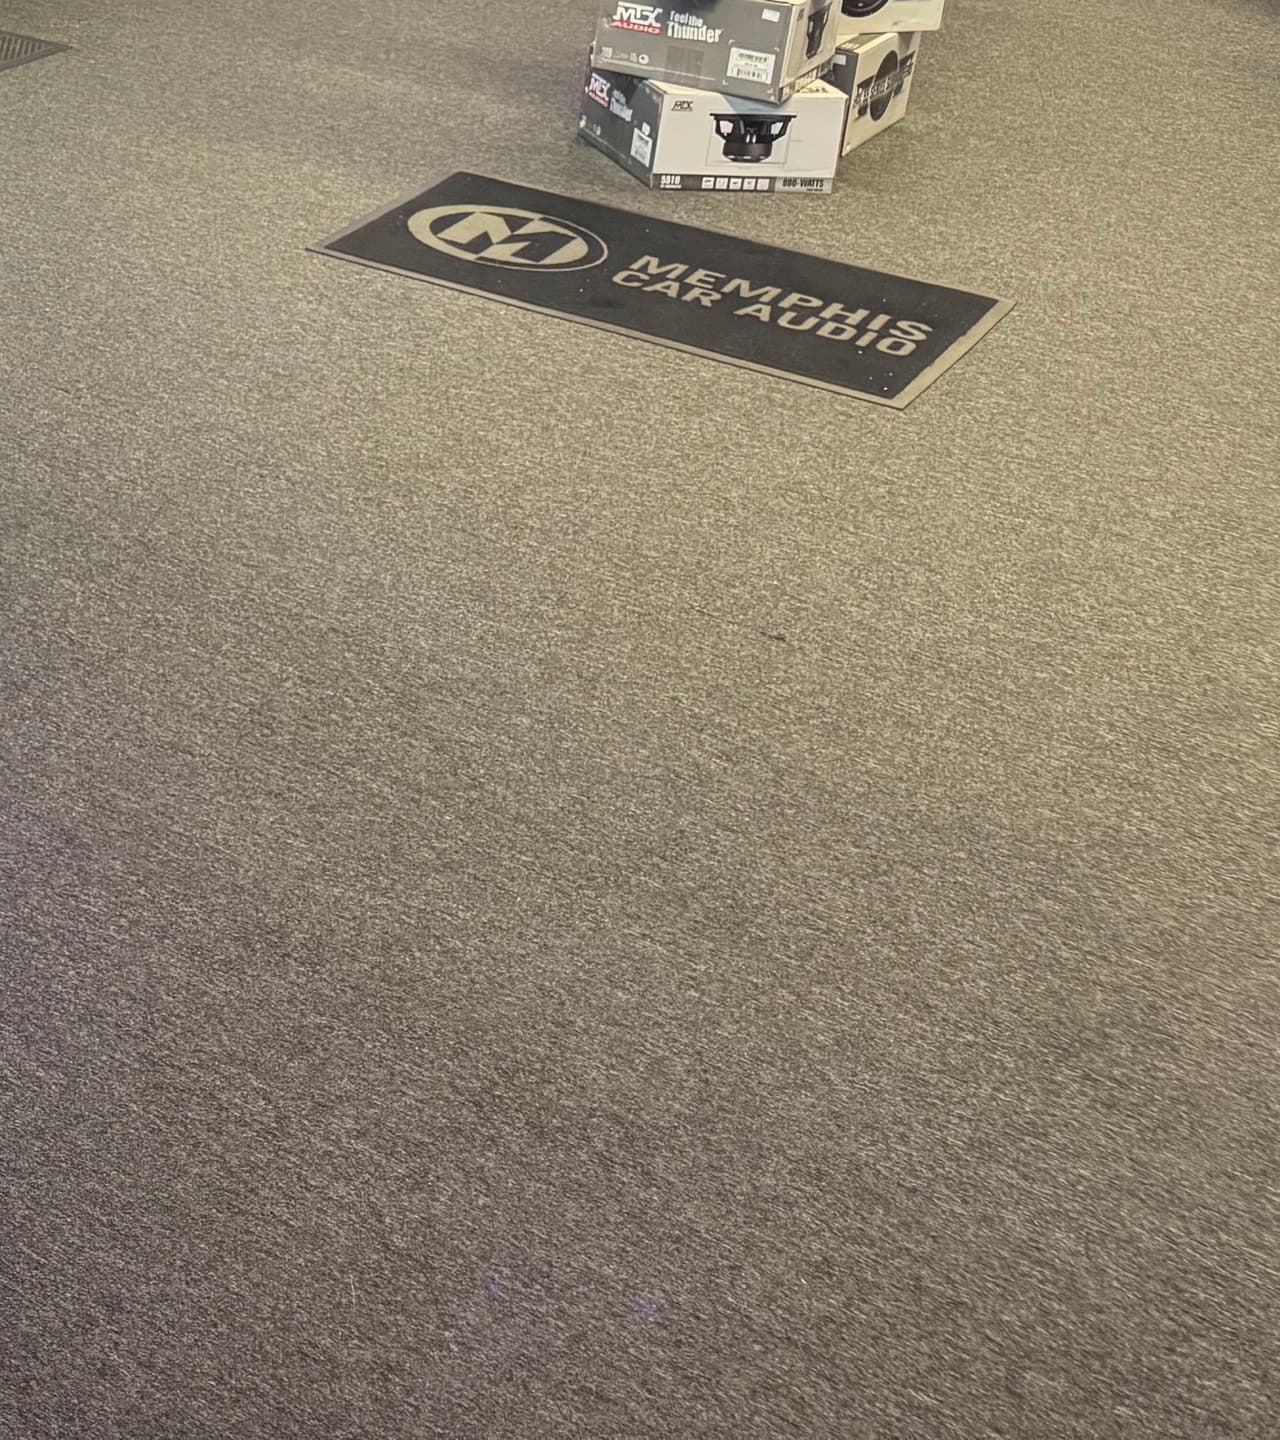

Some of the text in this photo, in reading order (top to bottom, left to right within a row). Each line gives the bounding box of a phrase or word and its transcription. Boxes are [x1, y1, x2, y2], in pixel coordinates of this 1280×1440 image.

[613, 1, 664, 27] MTX
[608, 20, 664, 35] AUDIO
[666, 21, 723, 44] Thunder
[632, 254, 934, 342] MEMPHIS
[611, 269, 918, 357] CAR AUDIO
